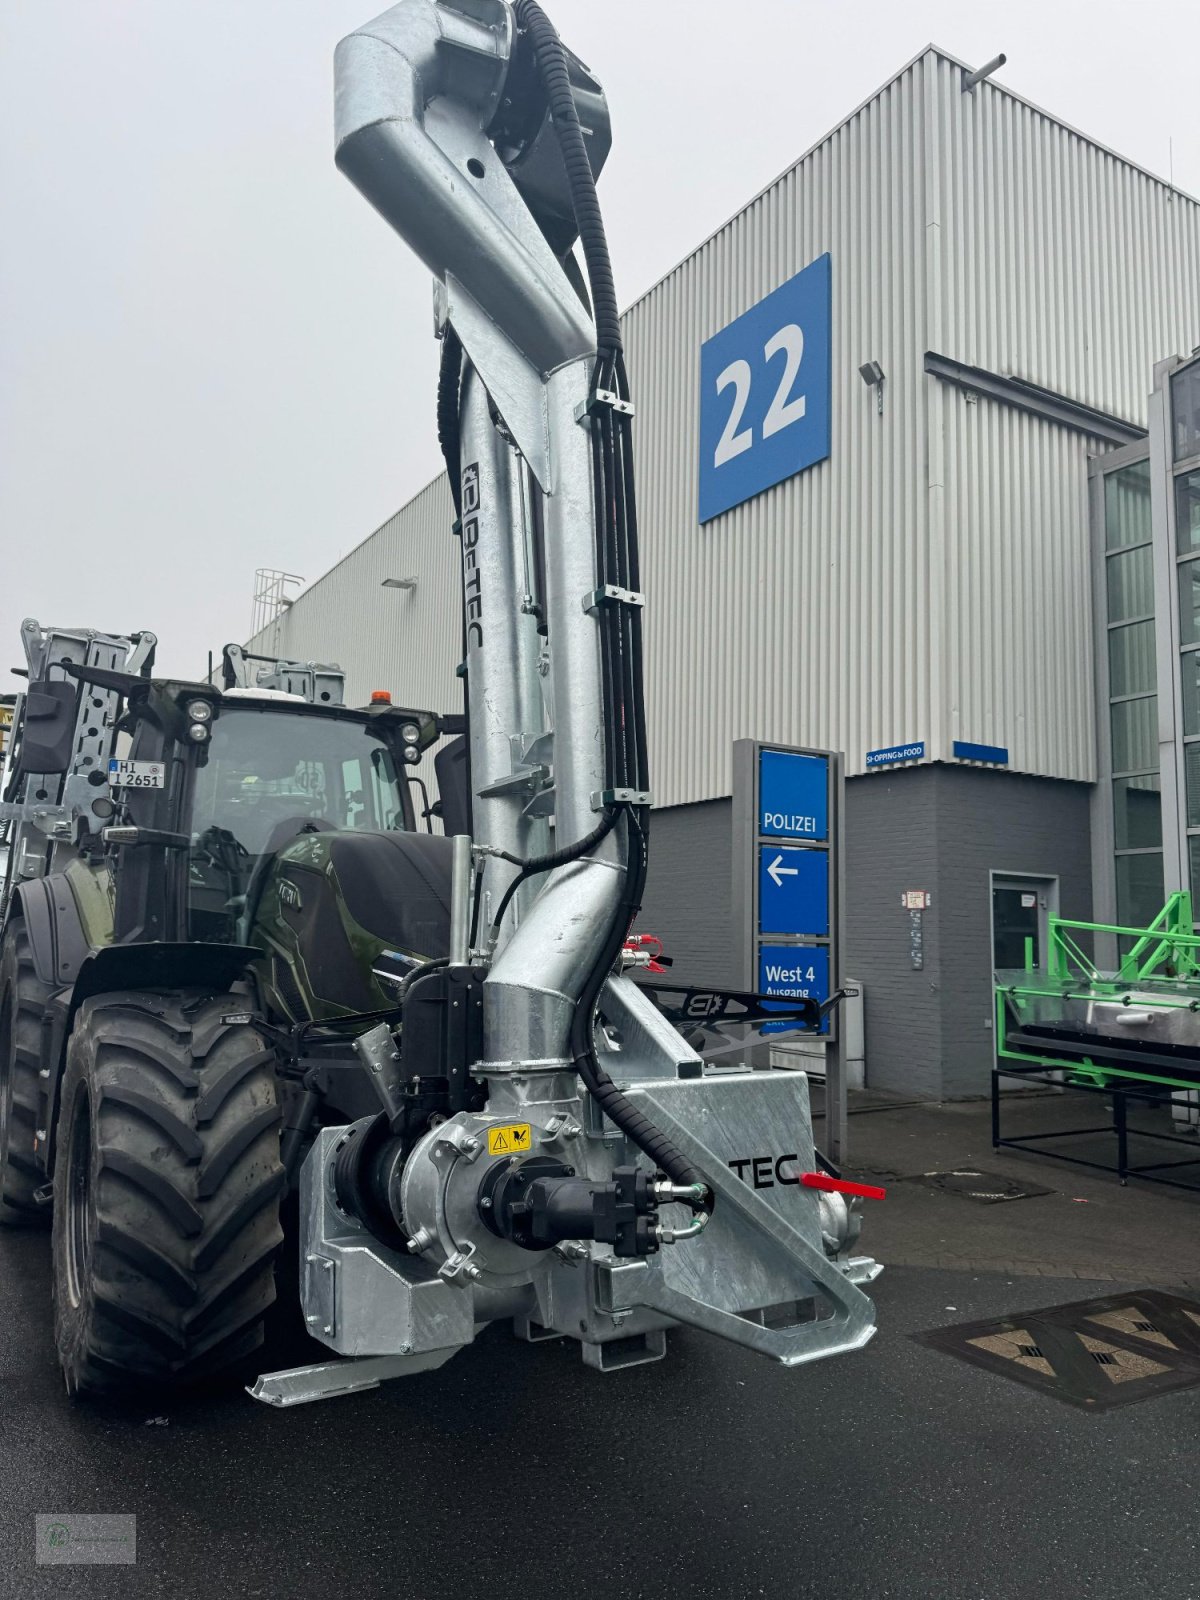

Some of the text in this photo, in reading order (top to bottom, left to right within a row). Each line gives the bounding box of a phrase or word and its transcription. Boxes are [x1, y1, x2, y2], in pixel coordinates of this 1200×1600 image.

[714, 324, 806, 469] 22
[904, 747, 922, 757] FOOD
[120, 761, 136, 774] HI
[126, 774, 159, 787] 2651
[764, 812, 816, 833] POLIZEI
[765, 965, 815, 982] West 4
[728, 1154, 800, 1190] TEC
